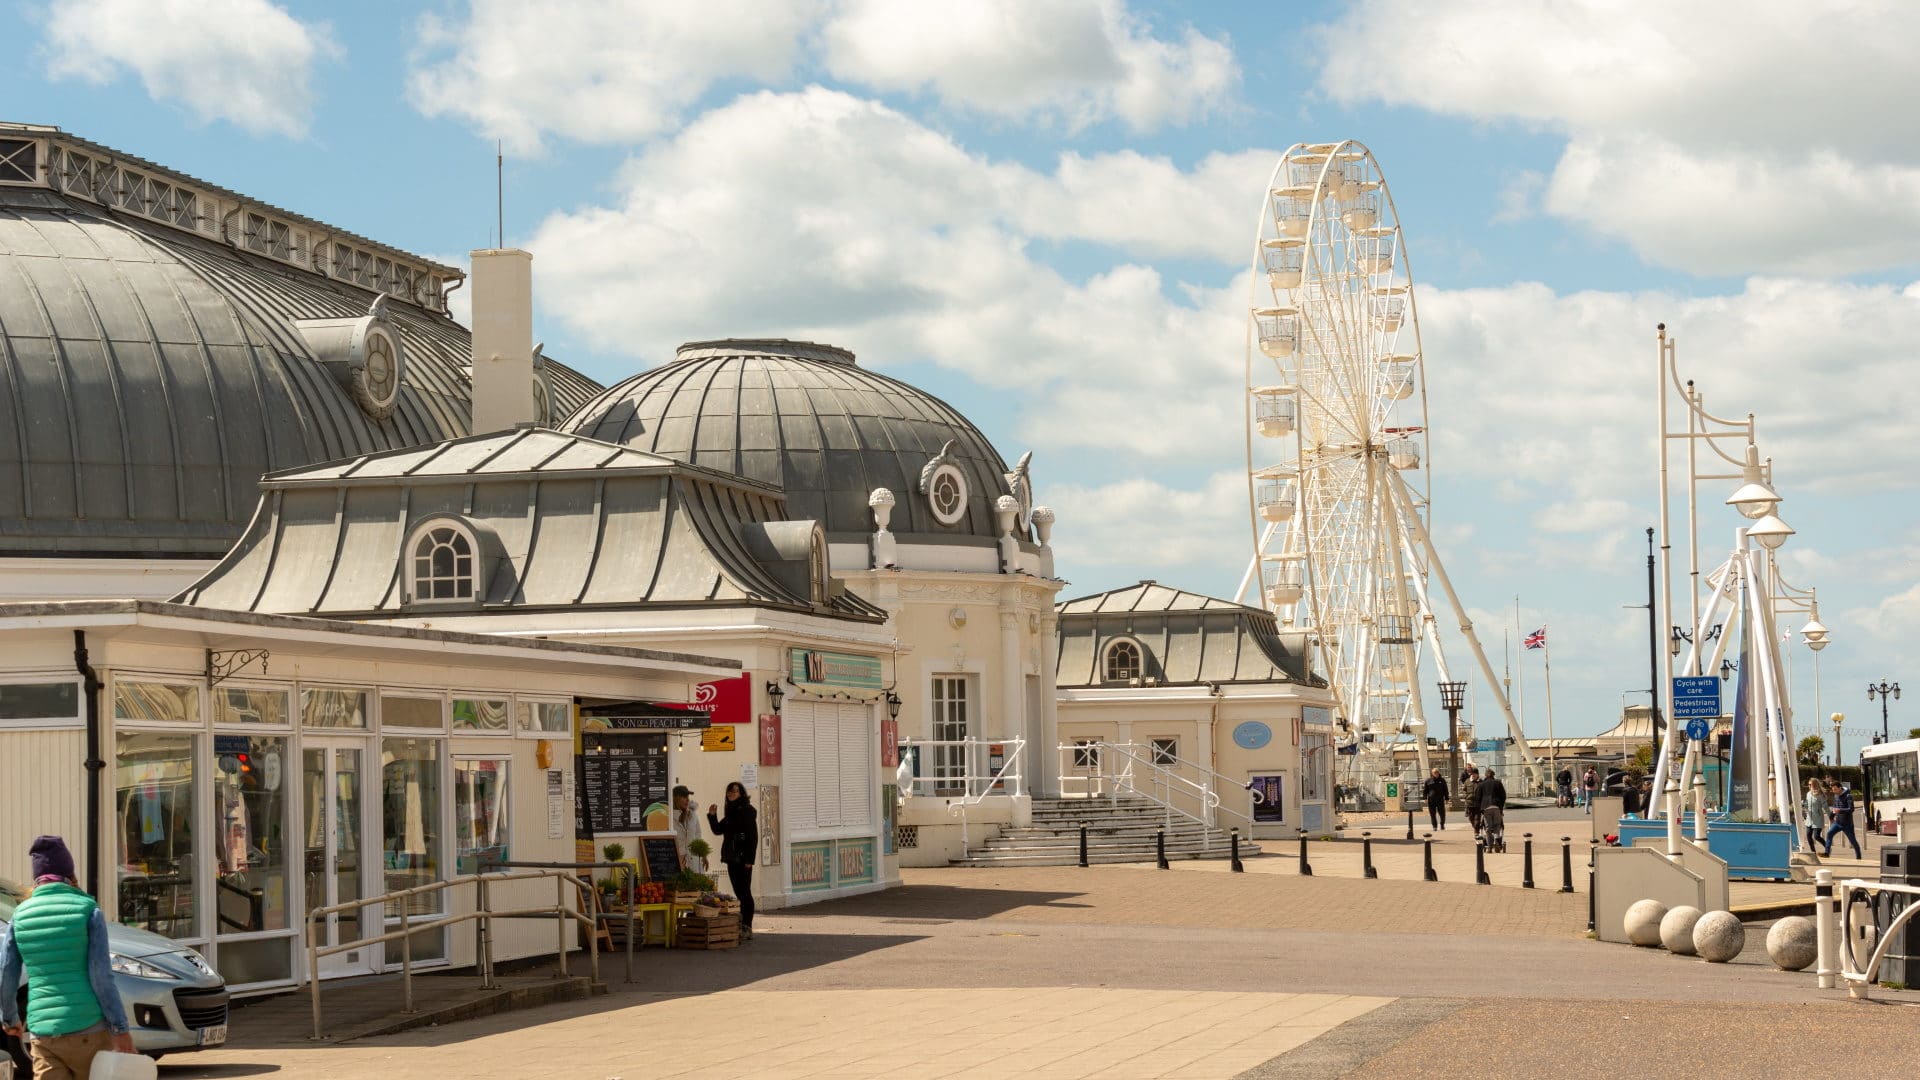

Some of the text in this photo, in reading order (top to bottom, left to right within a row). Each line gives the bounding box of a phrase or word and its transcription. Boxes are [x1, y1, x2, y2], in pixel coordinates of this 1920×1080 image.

[1676, 679, 1696, 688] Cycle
[687, 704, 716, 712] WALL'S
[618, 718, 636, 728] SON
[649, 718, 677, 728] PEACH
[839, 847, 864, 875] TREATS
